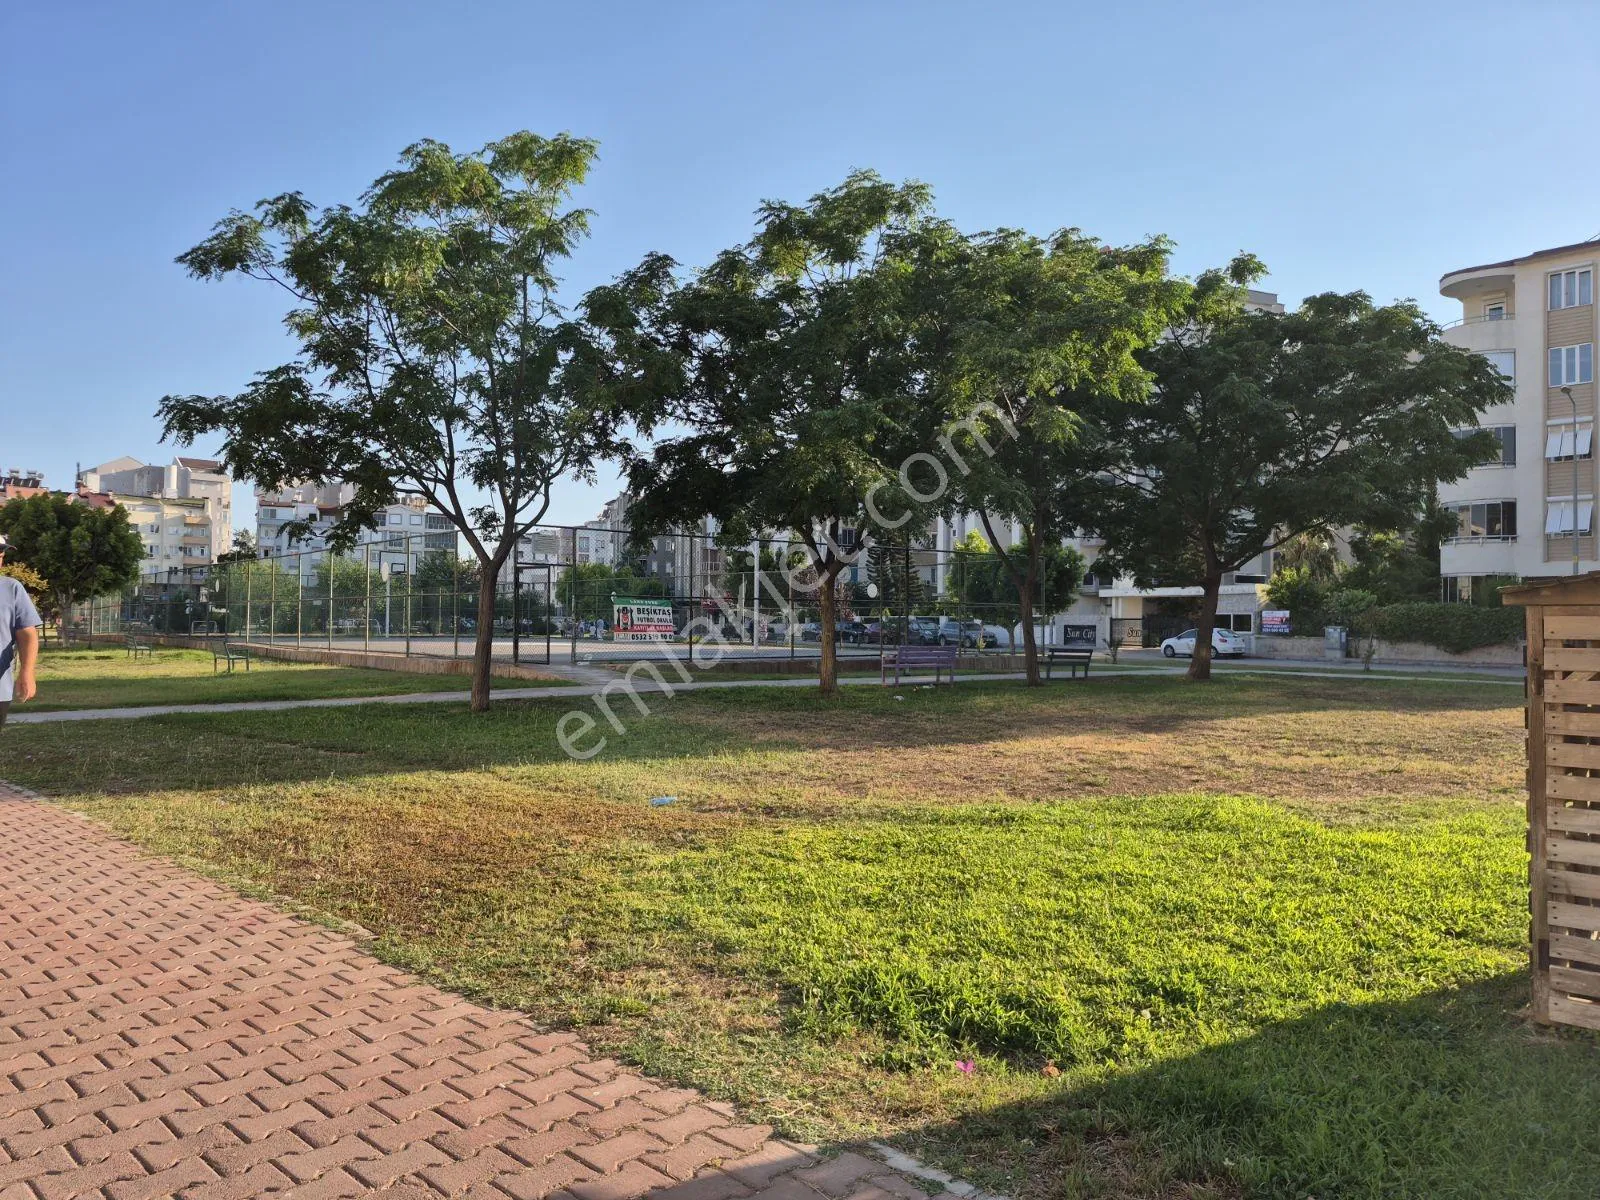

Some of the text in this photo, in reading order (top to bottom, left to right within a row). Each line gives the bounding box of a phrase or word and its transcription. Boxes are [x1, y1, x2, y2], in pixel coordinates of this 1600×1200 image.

[637, 606, 671, 618] BEŞİKTAŞ
[1066, 627, 1096, 641] Sun City
[1126, 626, 1142, 638] Sun
